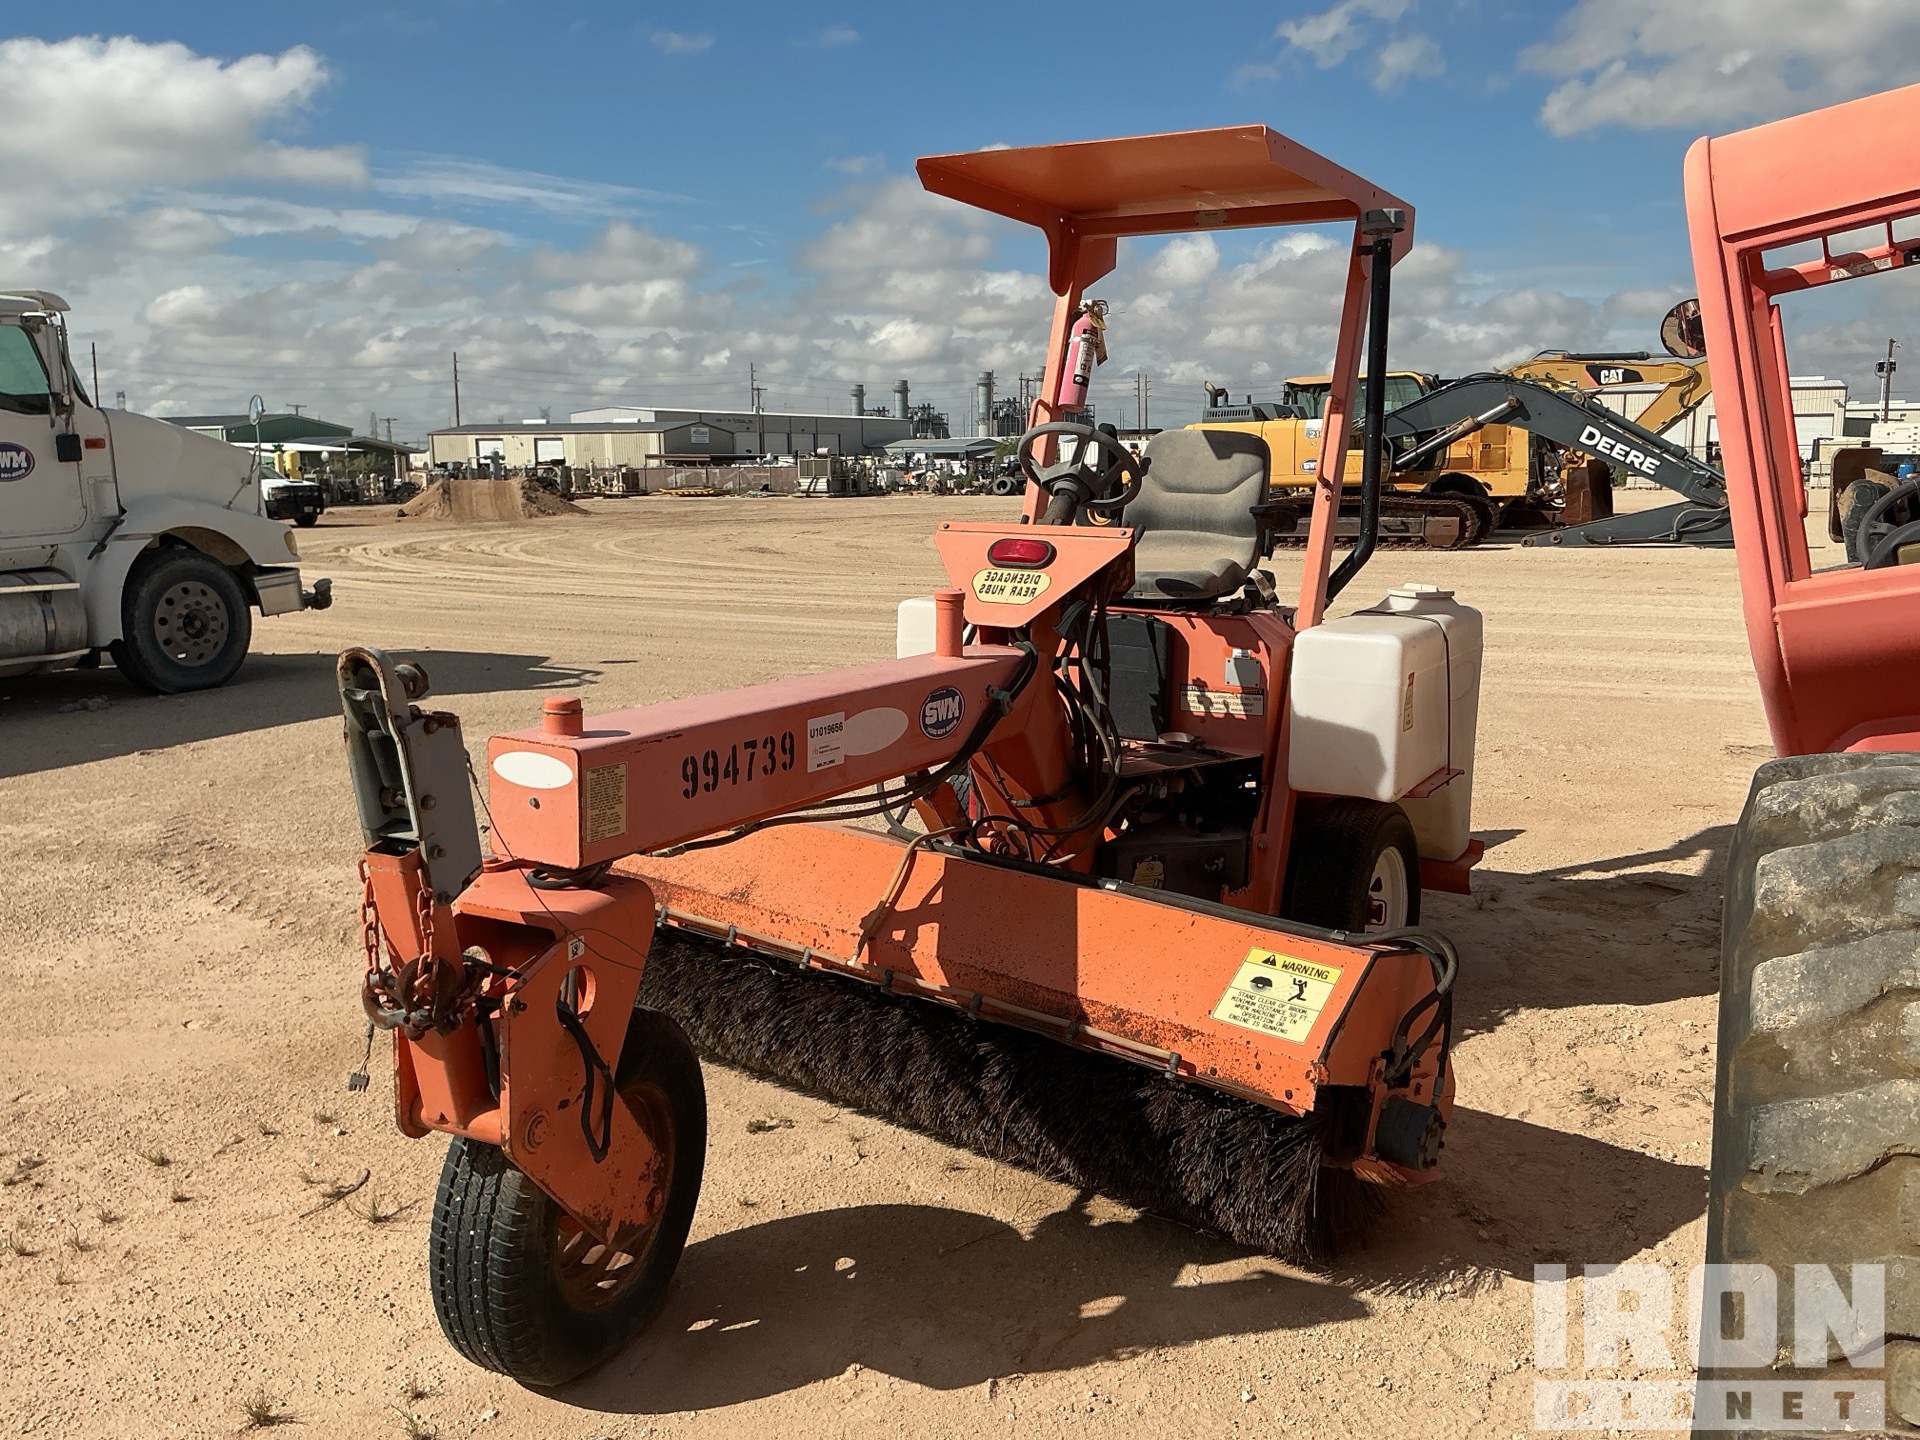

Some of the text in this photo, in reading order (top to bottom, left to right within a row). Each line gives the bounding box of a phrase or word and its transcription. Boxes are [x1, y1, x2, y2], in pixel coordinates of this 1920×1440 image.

[1600, 368, 1625, 385] CAT
[1578, 424, 1662, 476] DEERE
[925, 695, 960, 725] SWM
[681, 731, 796, 800] 994739
[1281, 960, 1330, 981] WARNING
[1231, 995, 1257, 1006] MINIMUM
[1258, 1003, 1287, 1016] DISTANCE
[1238, 991, 1256, 1001] STAND
[1258, 997, 1277, 1006] CLEAR
[1234, 1003, 1250, 1011] WHEN
[1251, 1007, 1277, 1019] MACHINE
[1242, 1011, 1274, 1025] OPERATION
[1228, 1013, 1250, 1024] ENGINE
[1262, 1024, 1289, 1035] RUNNING
